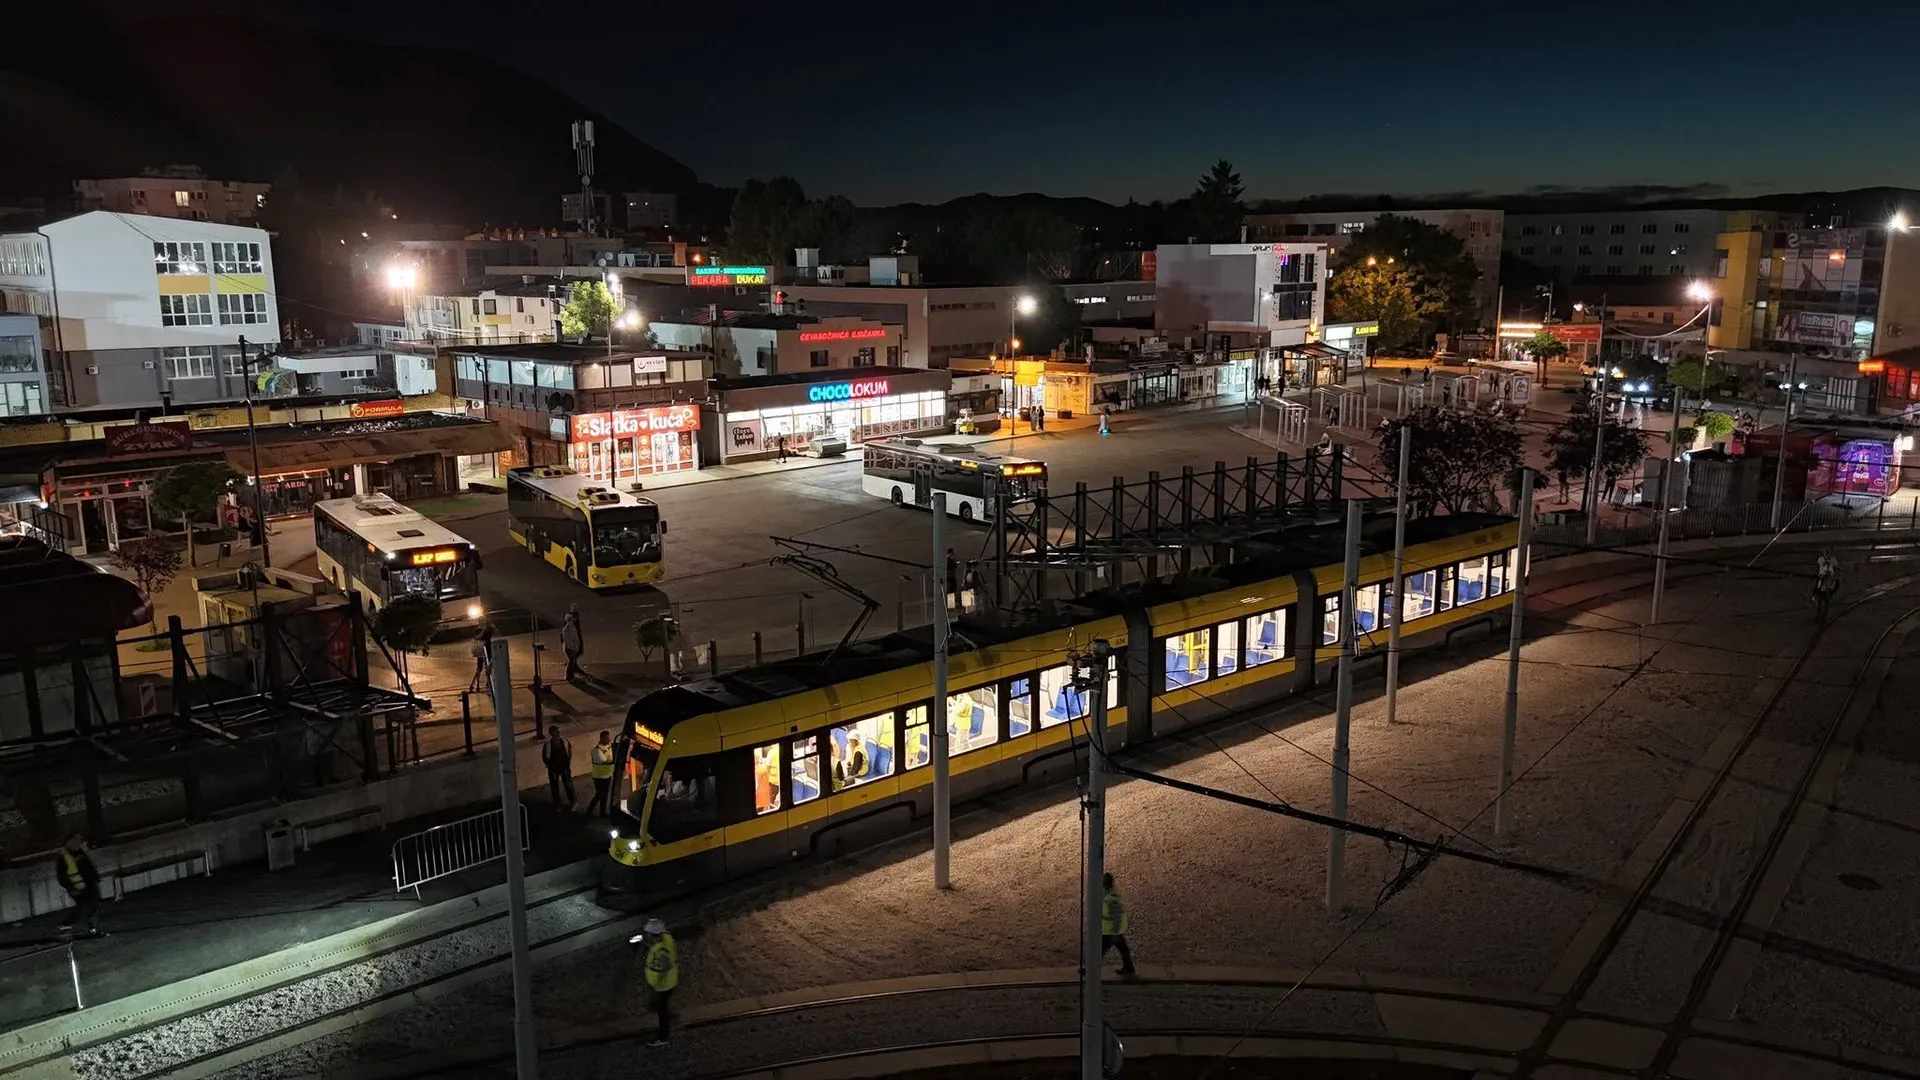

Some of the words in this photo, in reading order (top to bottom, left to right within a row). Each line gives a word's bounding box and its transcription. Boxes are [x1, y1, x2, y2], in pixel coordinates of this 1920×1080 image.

[691, 275, 728, 285] PEKARA
[736, 275, 765, 284] DUKAT
[809, 381, 888, 401] CHOCOLOKUM
[588, 415, 639, 437] Slatka
[649, 408, 685, 430] kuća
